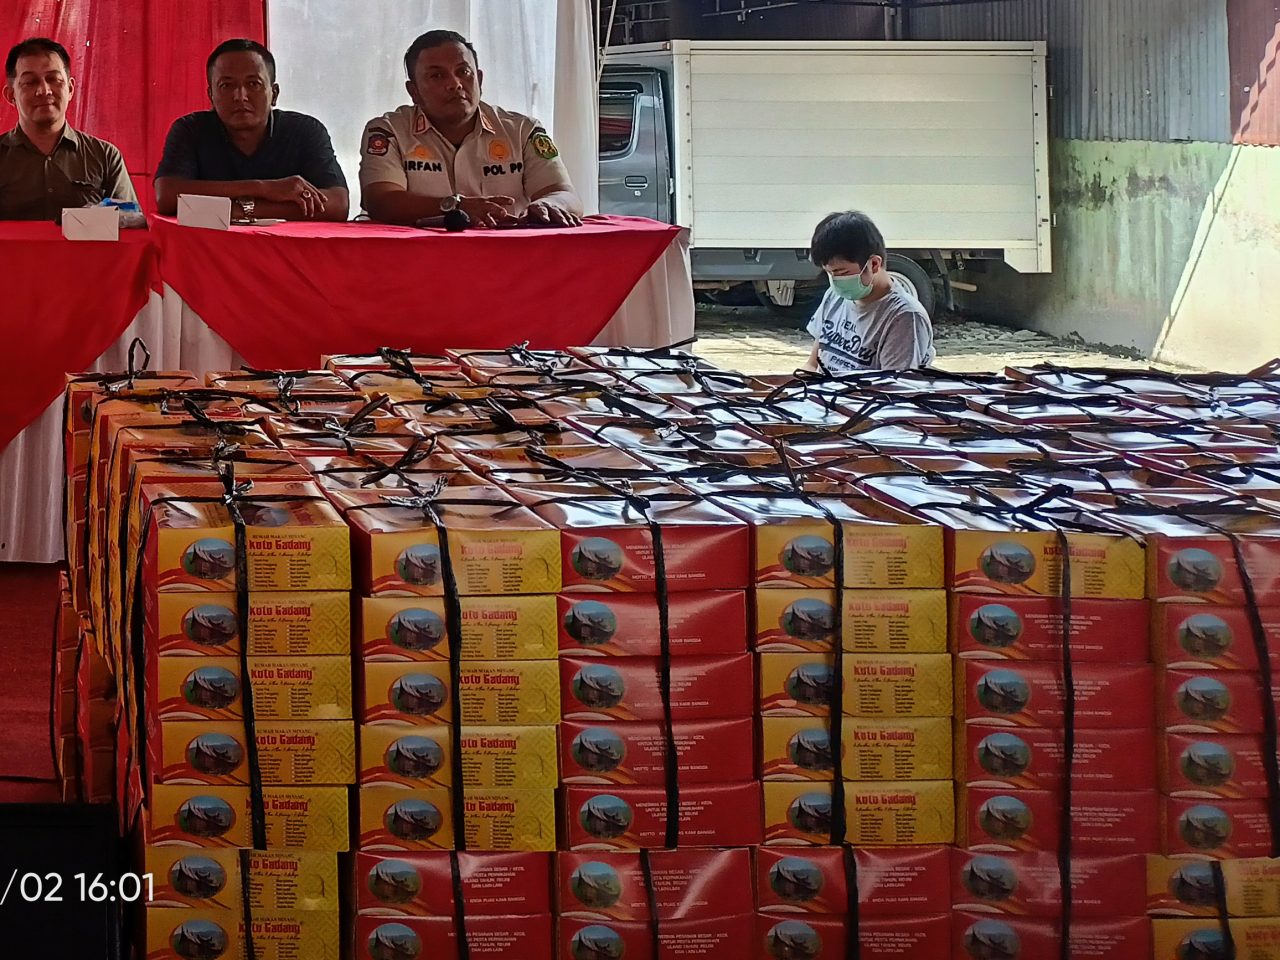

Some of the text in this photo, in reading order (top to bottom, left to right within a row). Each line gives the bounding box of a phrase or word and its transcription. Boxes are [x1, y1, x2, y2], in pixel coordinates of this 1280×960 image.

[404, 160, 443, 172] IRFAN
[482, 161, 523, 176] POL PP
